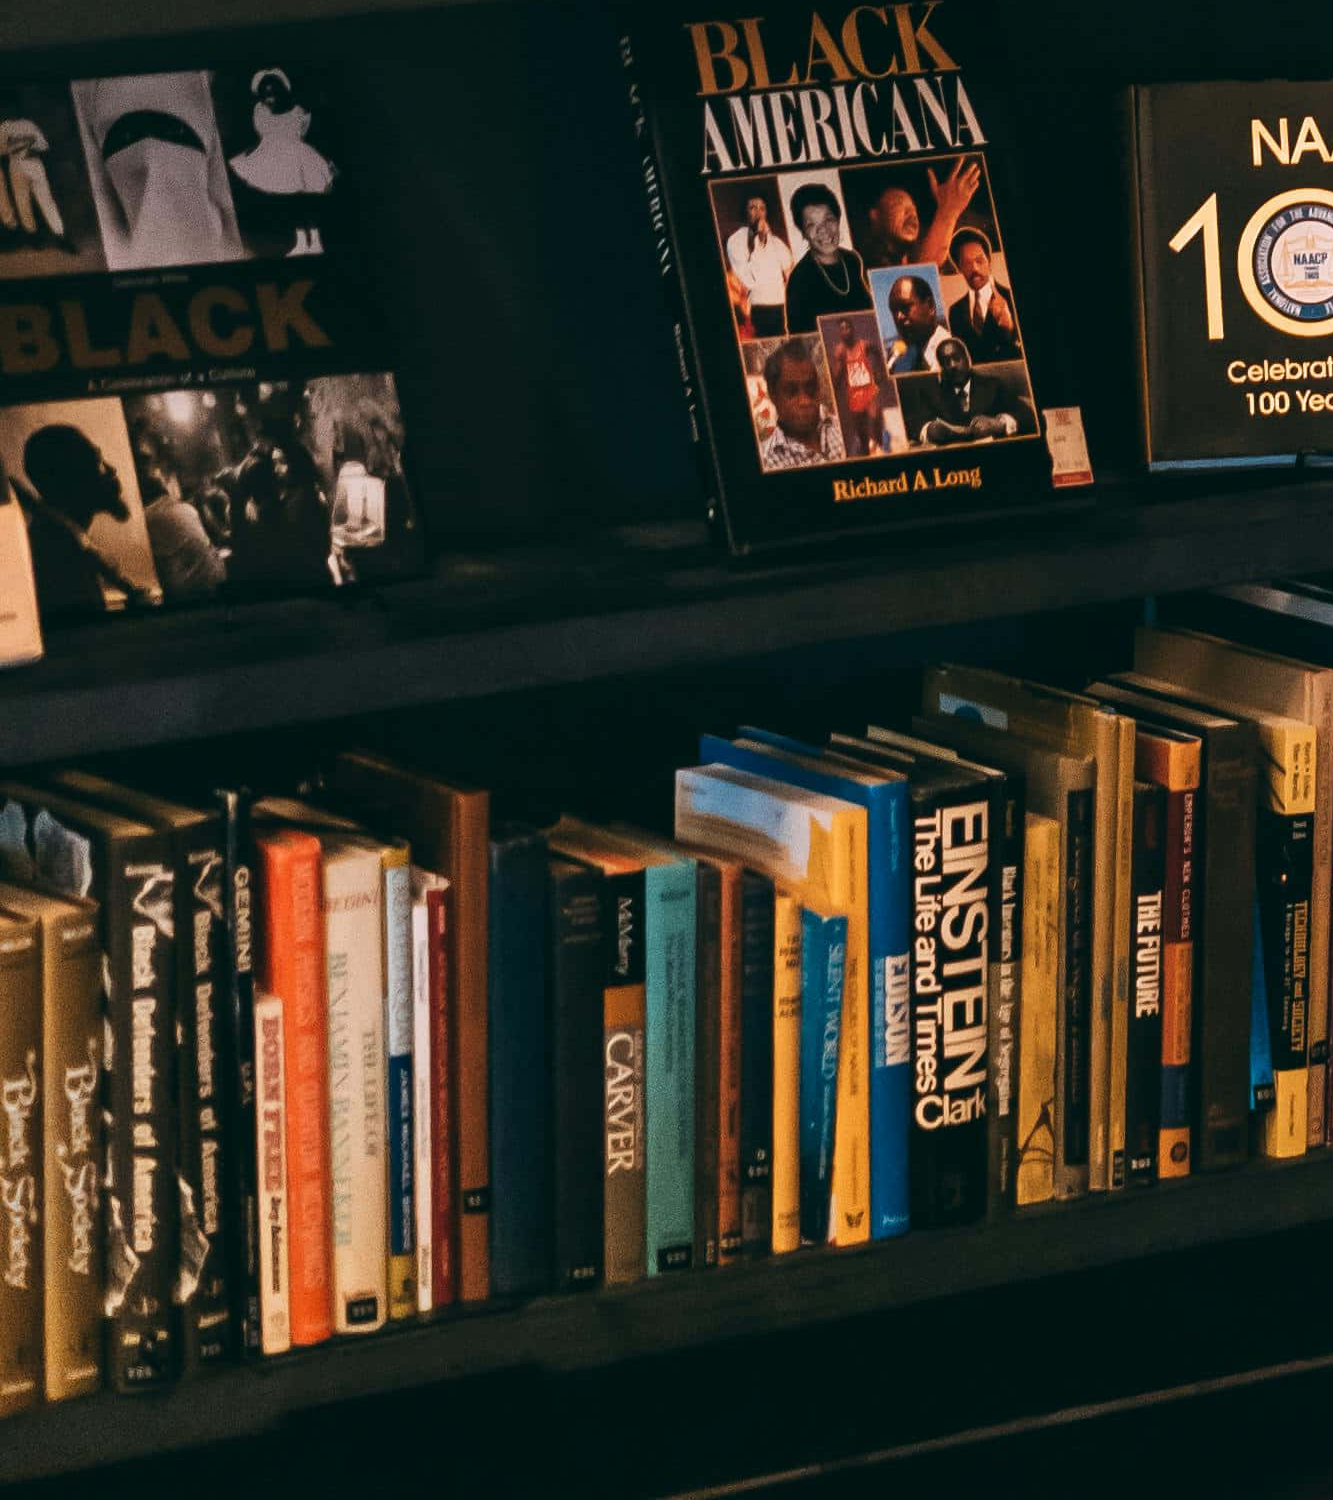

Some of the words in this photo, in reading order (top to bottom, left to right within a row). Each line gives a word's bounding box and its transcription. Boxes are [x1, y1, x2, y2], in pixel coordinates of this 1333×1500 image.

[682, 0, 962, 97] BLACK
[700, 76, 988, 175] AMERICANA
[1245, 389, 1291, 417] 100
[832, 471, 911, 502] Richard
[914, 471, 930, 491] A
[932, 466, 982, 492] Long
[915, 808, 941, 871] The
[915, 874, 940, 932] Life
[1138, 891, 1161, 934] THE
[915, 934, 941, 991] and
[941, 800, 989, 1091] EINSTEIN
[1135, 935, 1160, 1019] FUTURE
[915, 1000, 941, 1092] Times
[605, 1032, 634, 1176] CARVER
